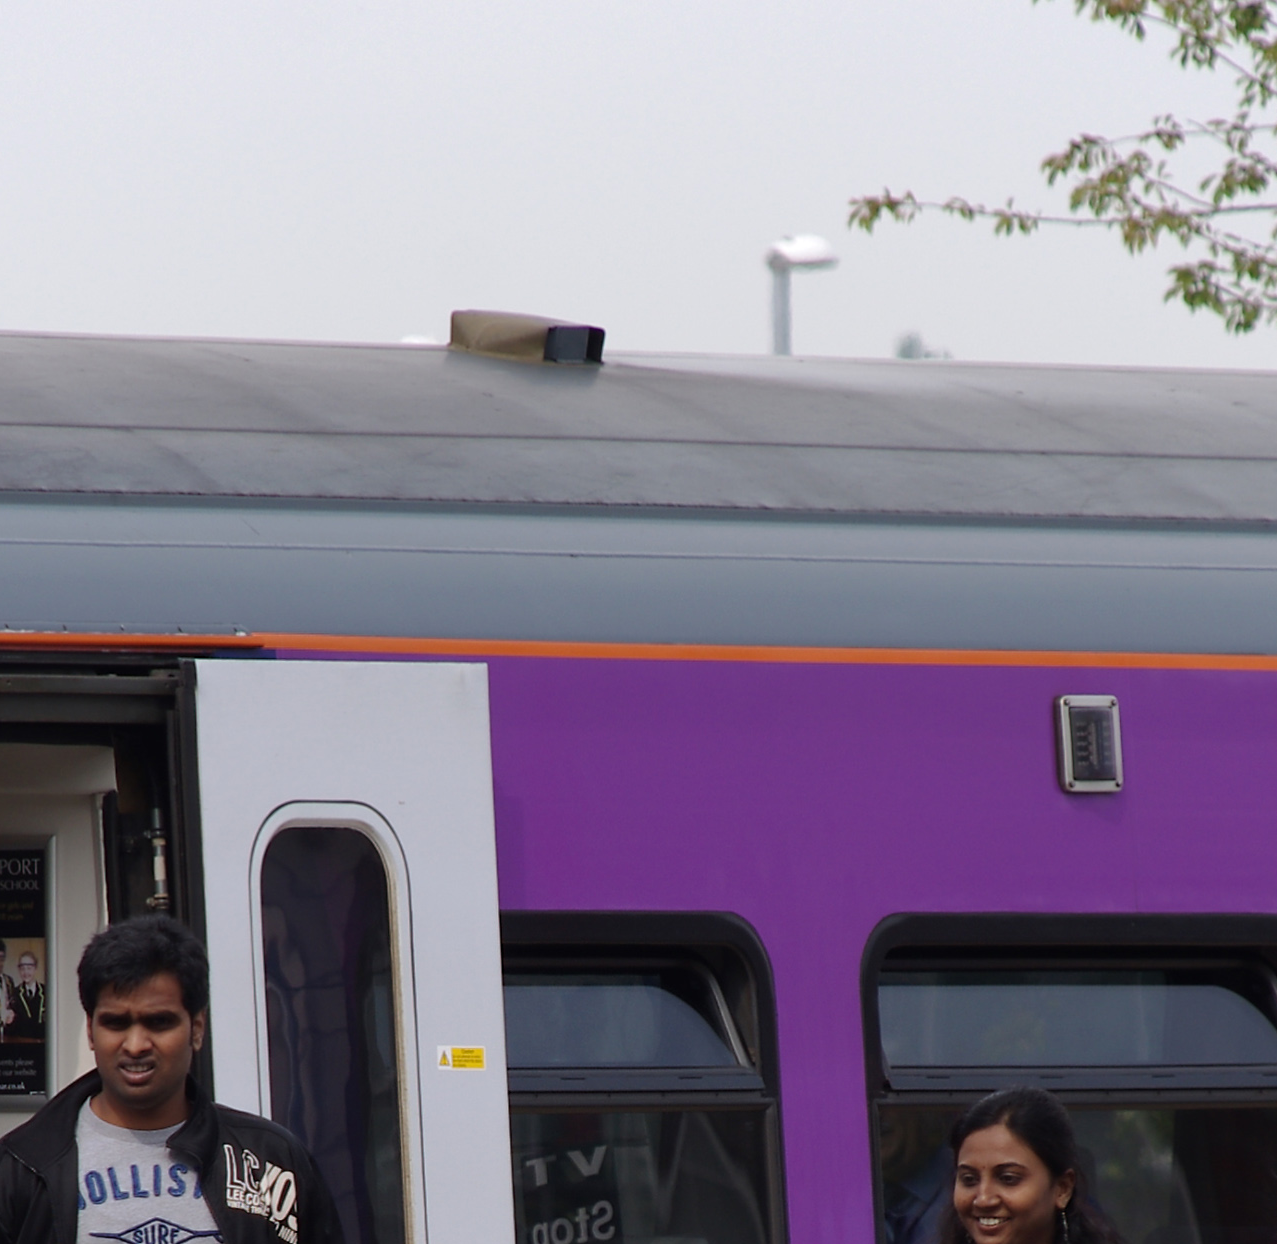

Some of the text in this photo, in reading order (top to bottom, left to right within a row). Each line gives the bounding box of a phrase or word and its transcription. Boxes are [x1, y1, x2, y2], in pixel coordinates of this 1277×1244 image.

[0, 879, 40, 891] SCHOOL
[15, 1057, 34, 1068] please
[14, 1068, 37, 1076] website
[78, 1163, 204, 1210] OLLIS
[227, 1188, 246, 1202] LEE
